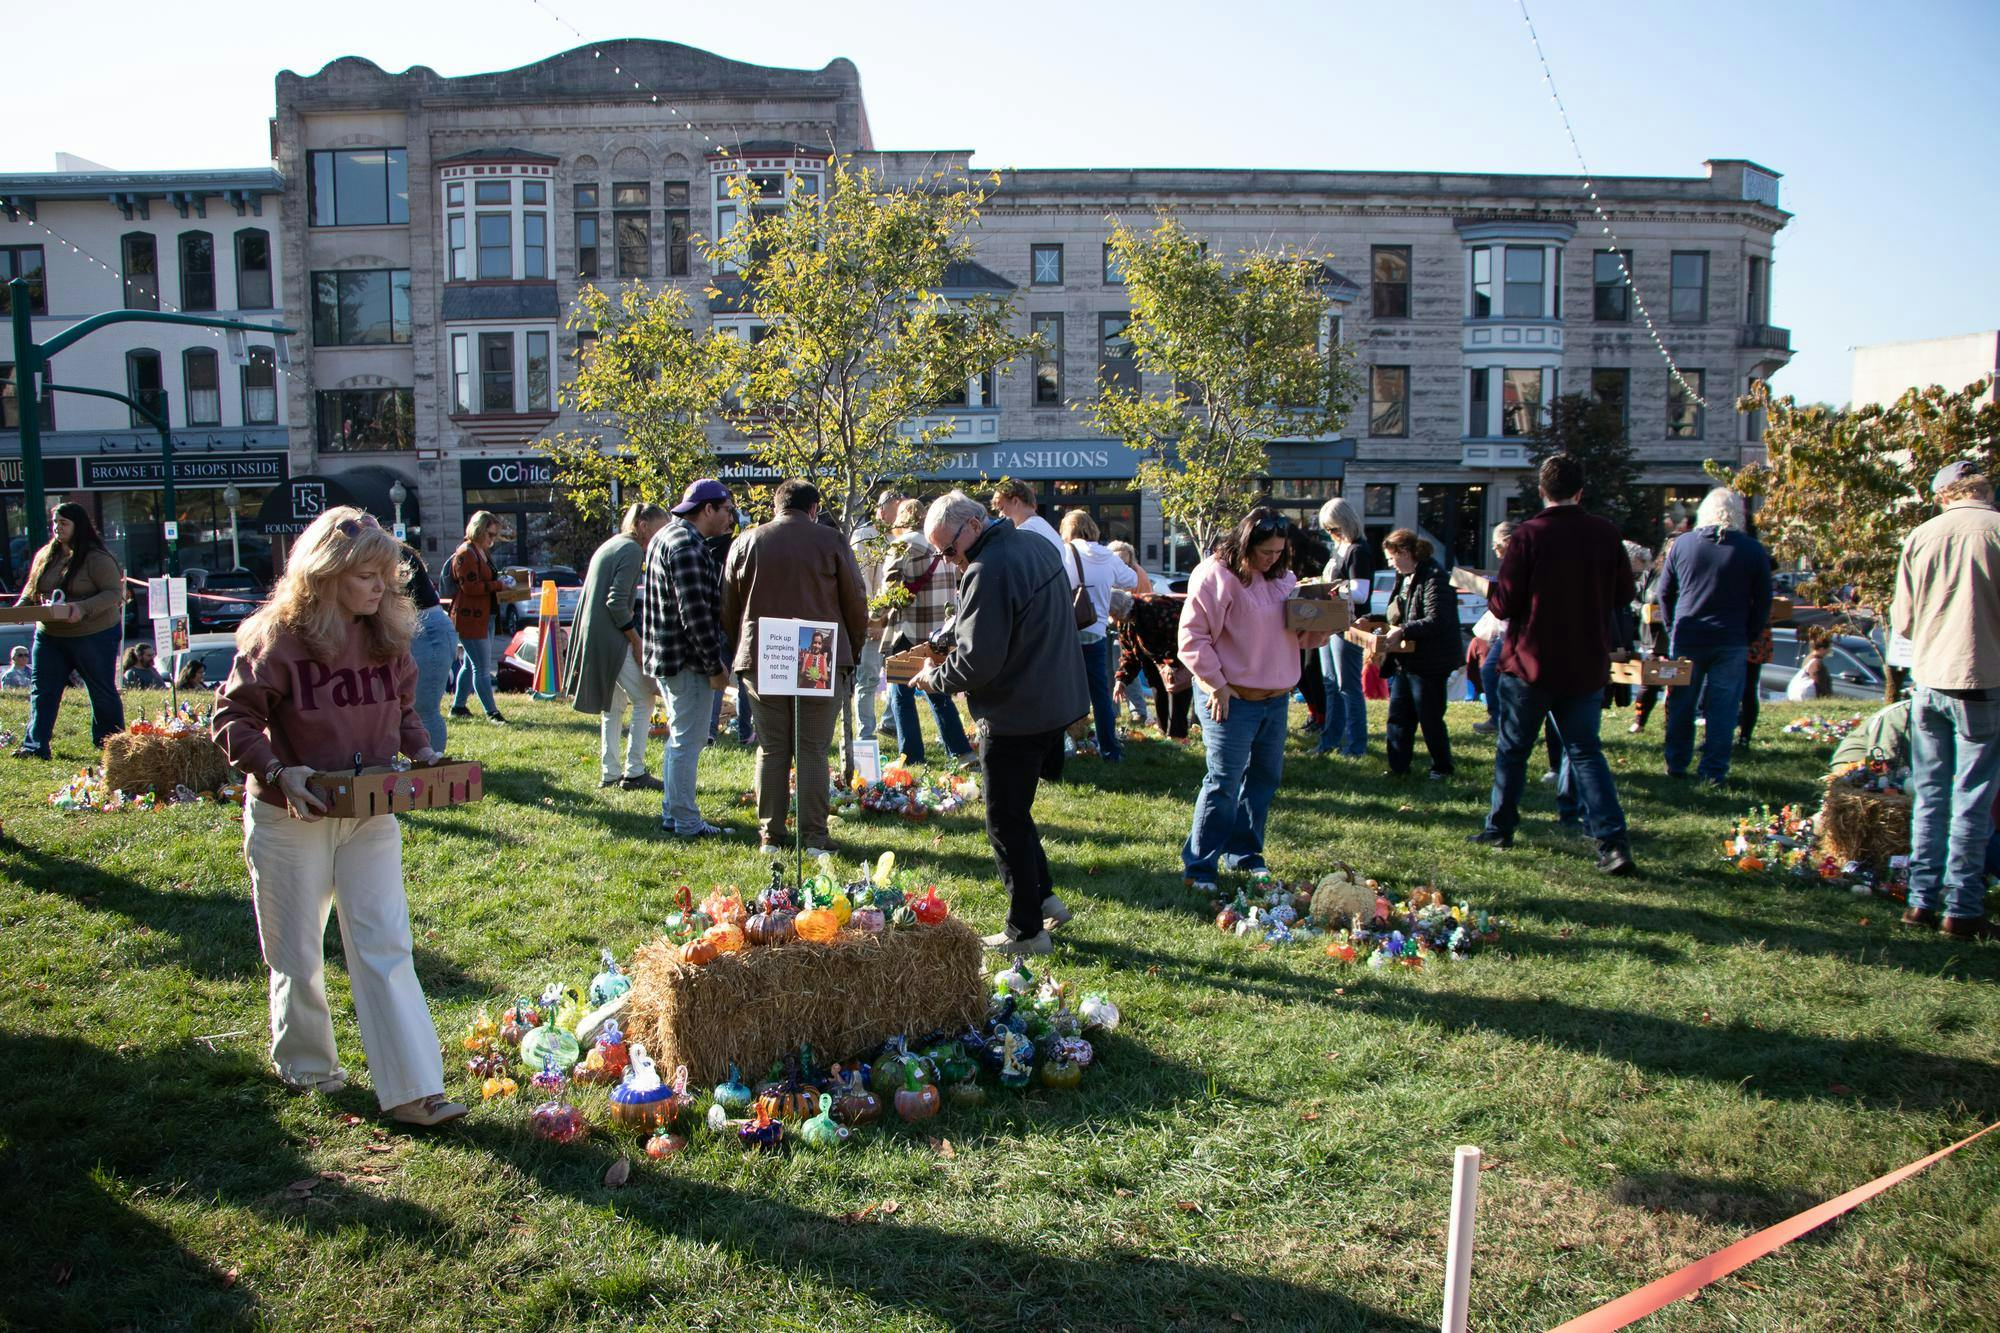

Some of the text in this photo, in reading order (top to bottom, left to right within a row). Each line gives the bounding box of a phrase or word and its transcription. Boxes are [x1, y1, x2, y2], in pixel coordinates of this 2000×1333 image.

[992, 450, 1109, 468] FASHIONS
[92, 465, 147, 479] BROWSE
[184, 463, 228, 476] SHOPS
[231, 461, 279, 475] INSIDE
[763, 653, 770, 661] by
